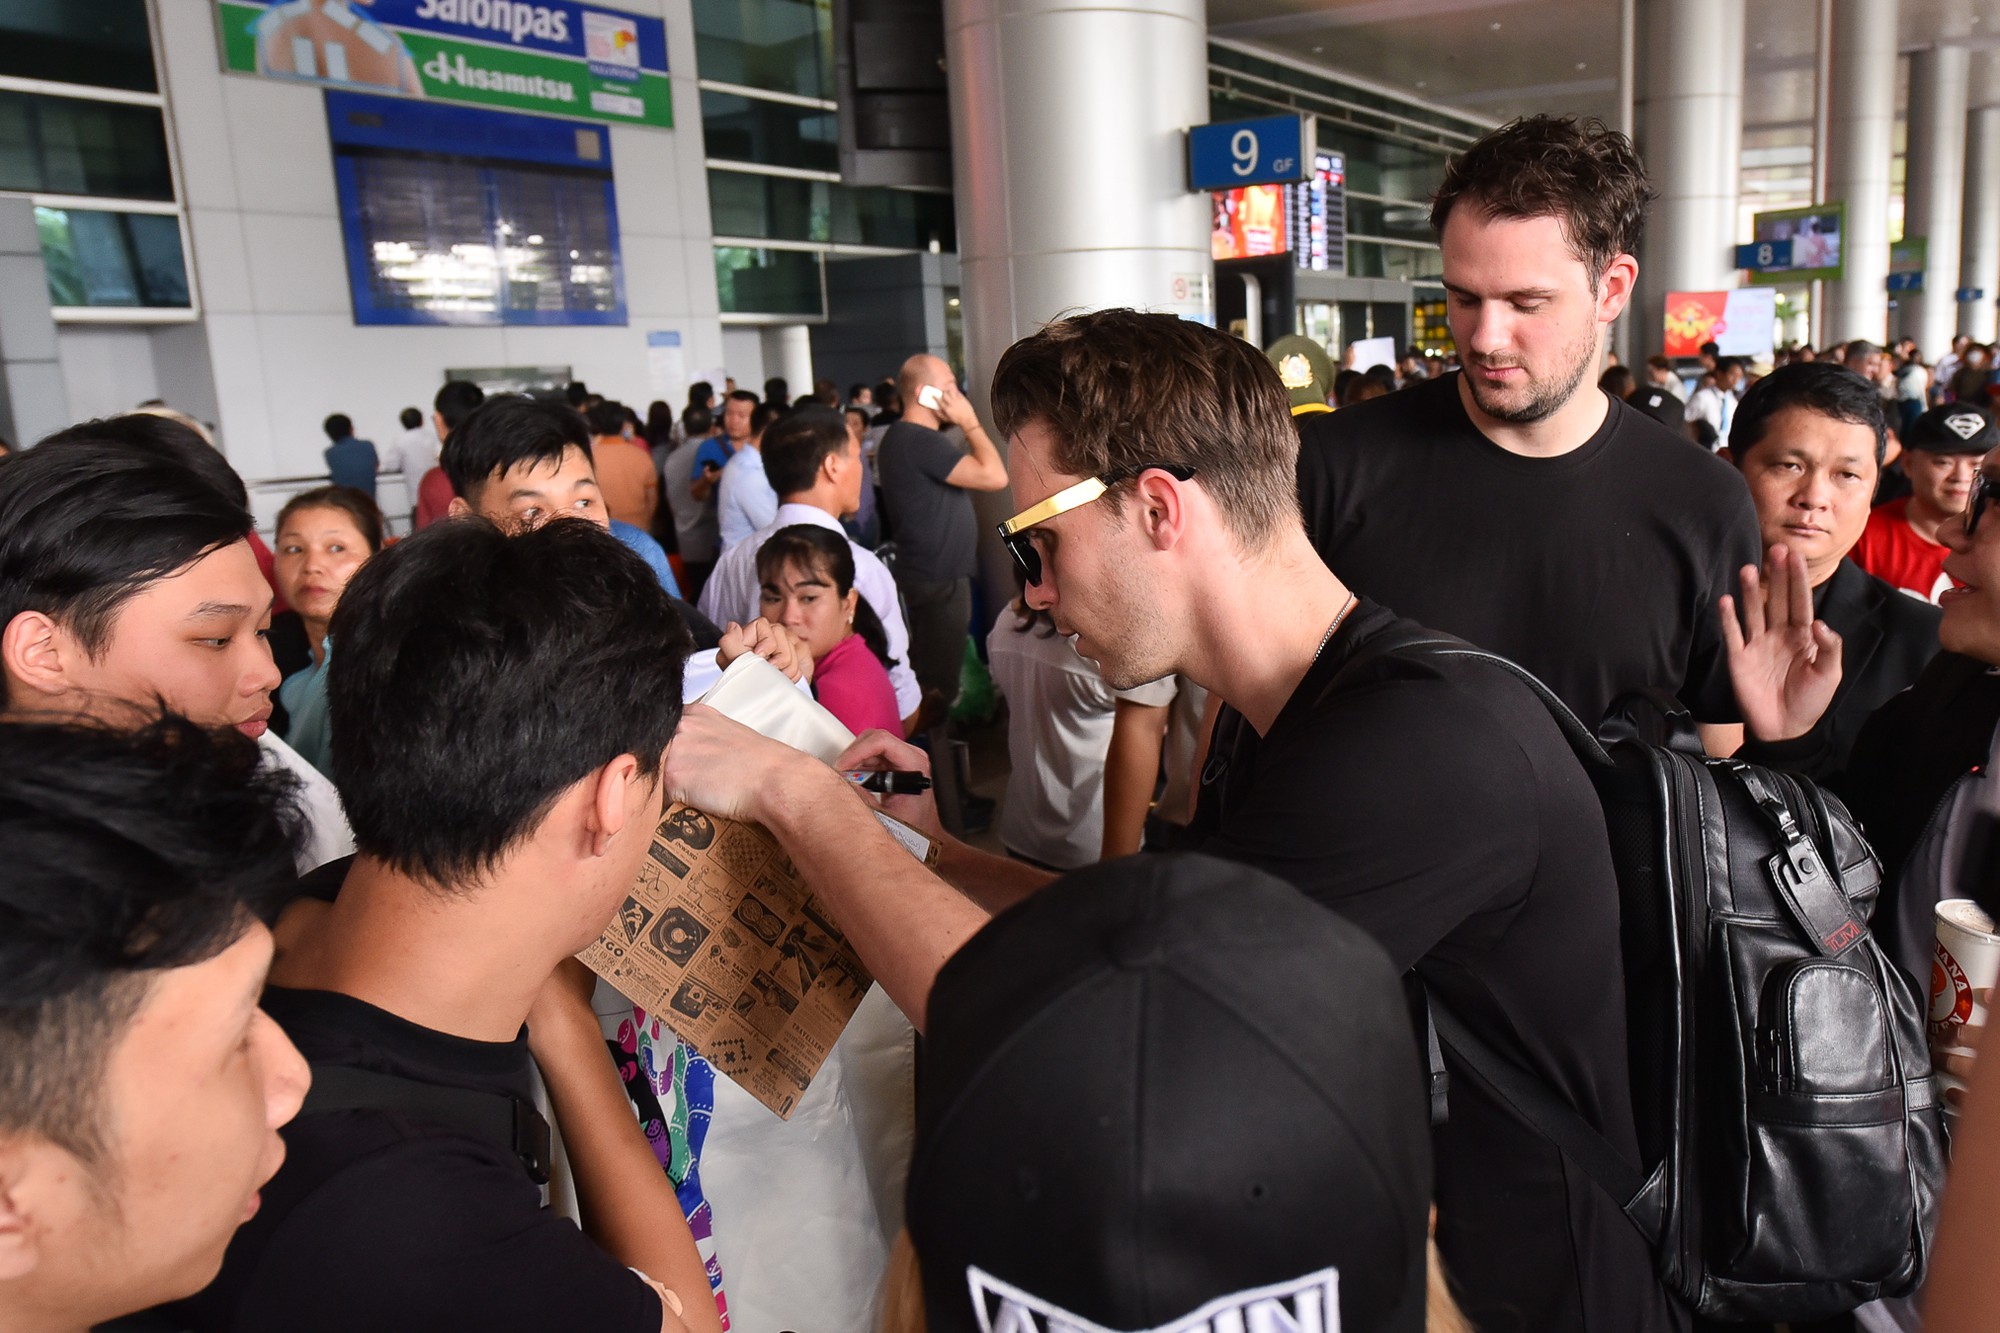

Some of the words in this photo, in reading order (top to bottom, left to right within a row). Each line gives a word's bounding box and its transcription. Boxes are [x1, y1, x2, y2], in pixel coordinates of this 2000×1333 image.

[423, 51, 572, 101] Hisamitsu
[1231, 129, 1259, 176] 9
[1273, 158, 1294, 173] GF
[1757, 243, 1774, 265] 8
[675, 841, 698, 861] INWARD
[1824, 920, 1862, 951] TUMI
[792, 1023, 825, 1054] TRAVELLERS
